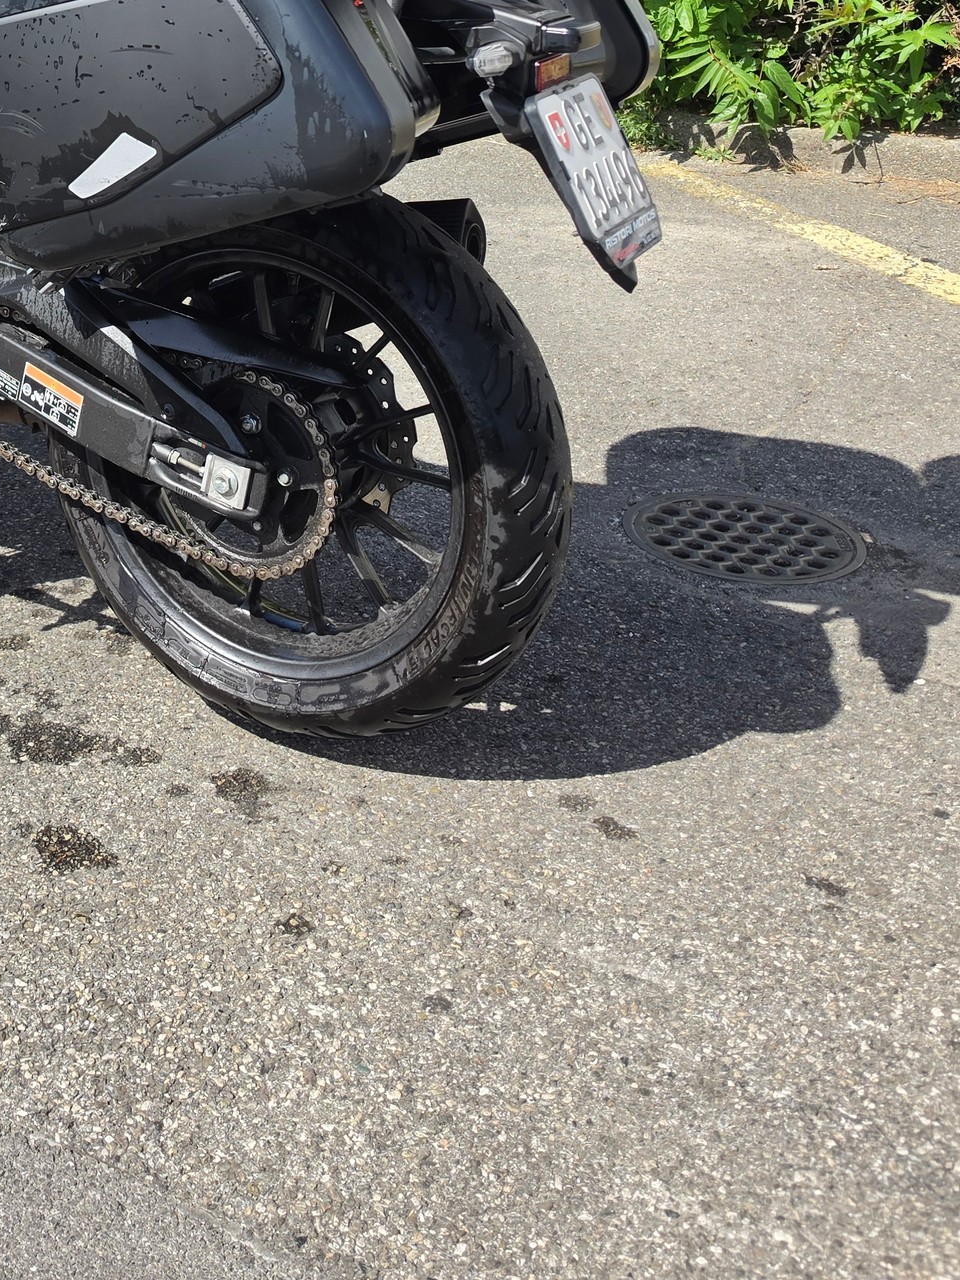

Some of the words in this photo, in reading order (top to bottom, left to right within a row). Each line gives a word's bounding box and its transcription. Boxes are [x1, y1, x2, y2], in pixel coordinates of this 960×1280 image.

[562, 92, 605, 151] GE
[573, 150, 646, 229] 134496
[605, 223, 633, 250] RISTORI
